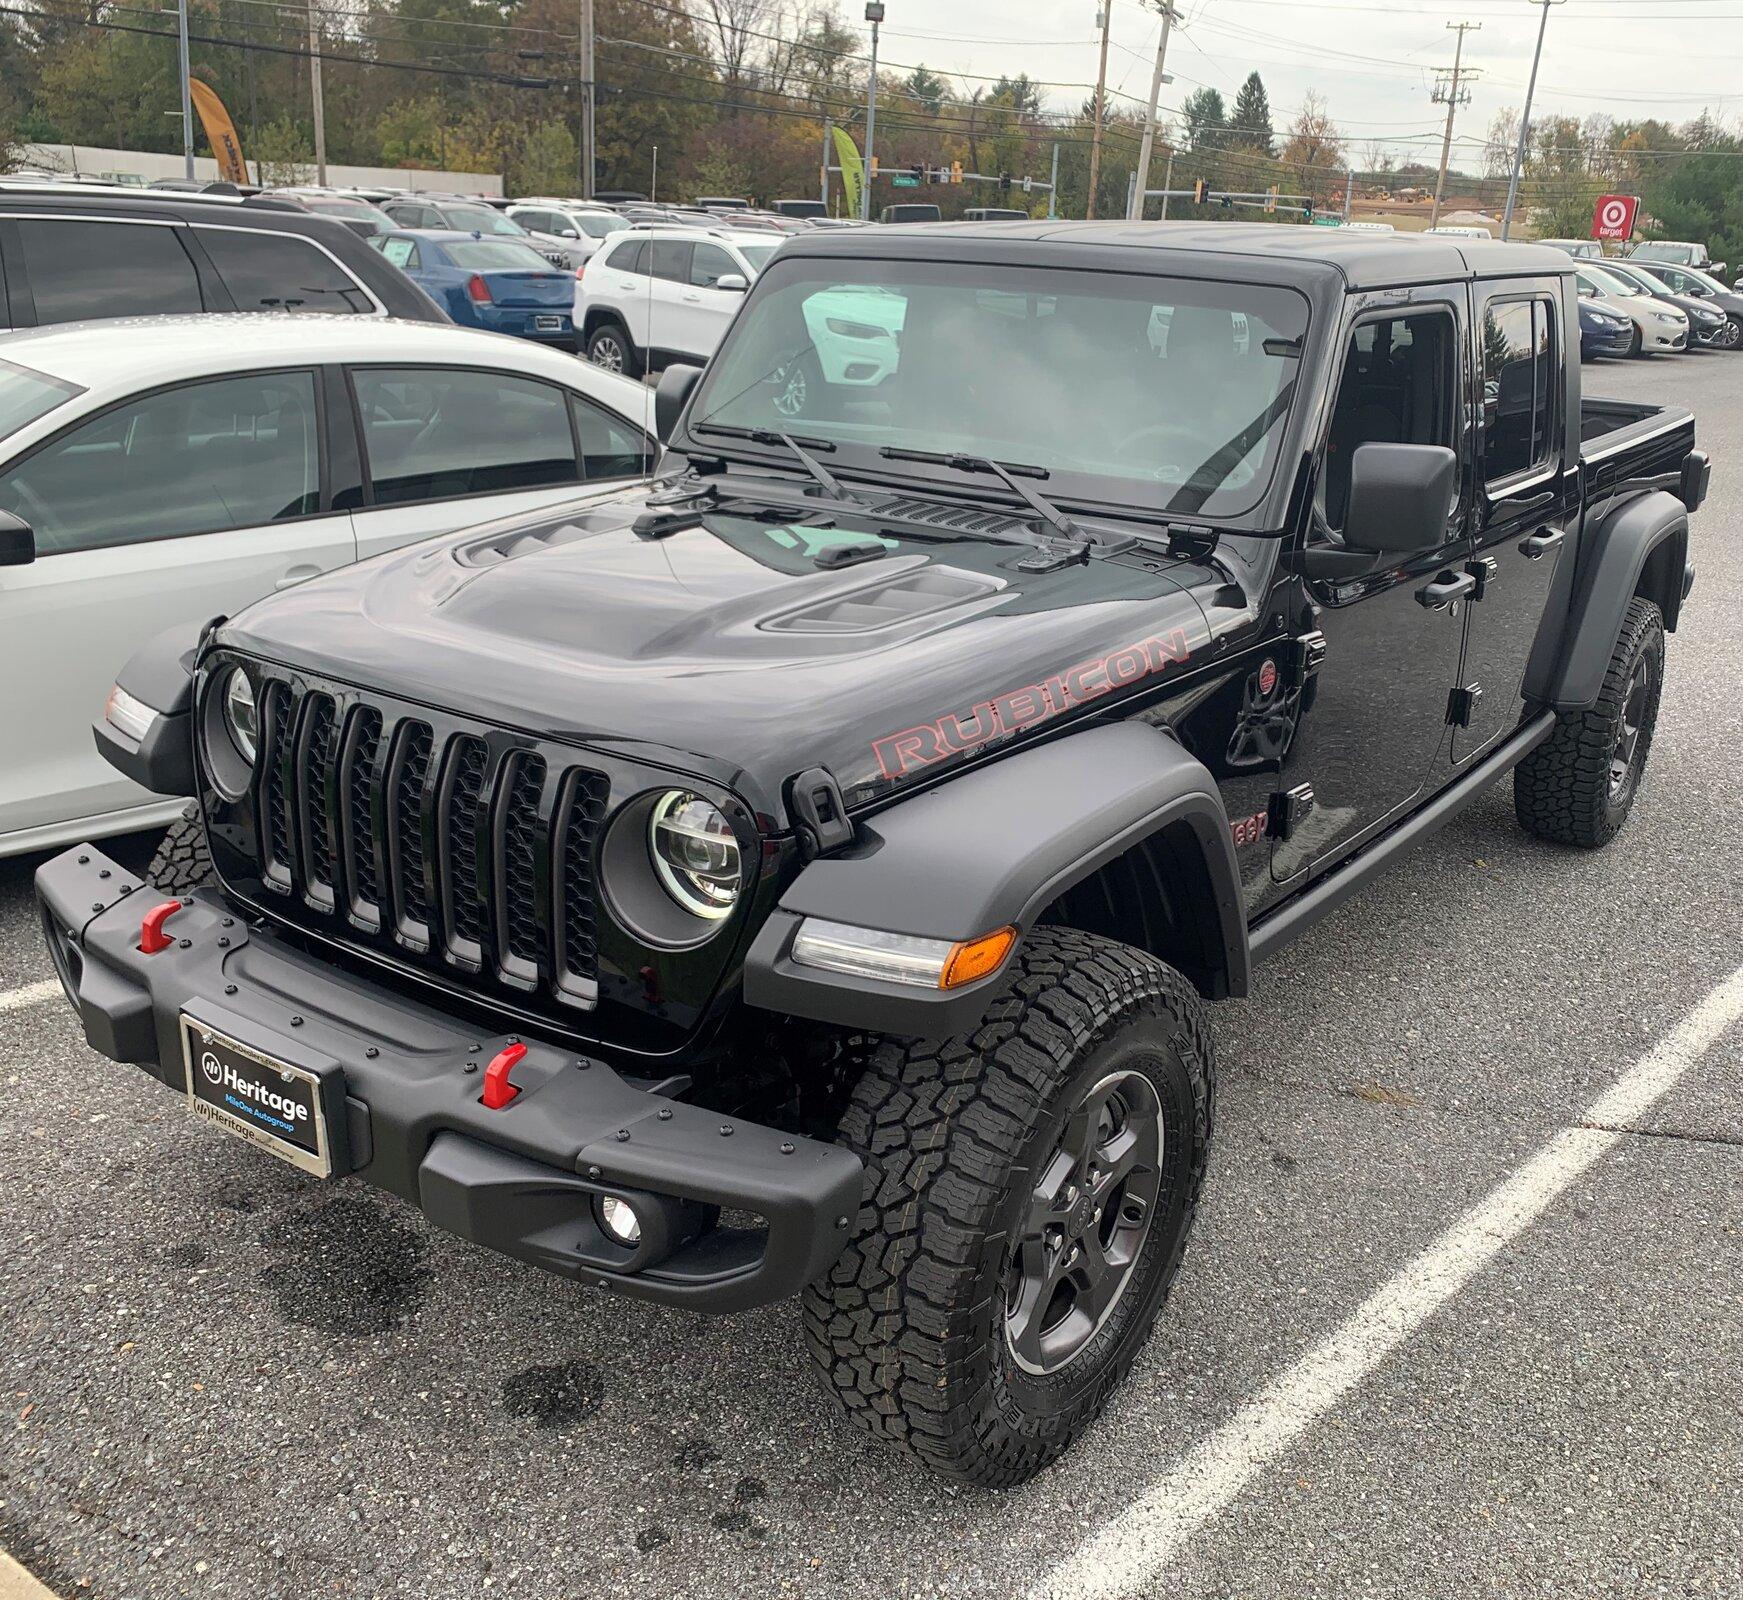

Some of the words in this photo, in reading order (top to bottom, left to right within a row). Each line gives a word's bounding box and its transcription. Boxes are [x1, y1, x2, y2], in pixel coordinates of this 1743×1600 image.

[1599, 226, 1623, 237] target
[871, 628, 1191, 780] RUBICON
[1229, 811, 1269, 845] eep
[224, 1064, 308, 1121] Heritage
[210, 1107, 255, 1140] Heritage
[225, 1093, 253, 1115] MileOne
[253, 1108, 295, 1133] Autogroup
